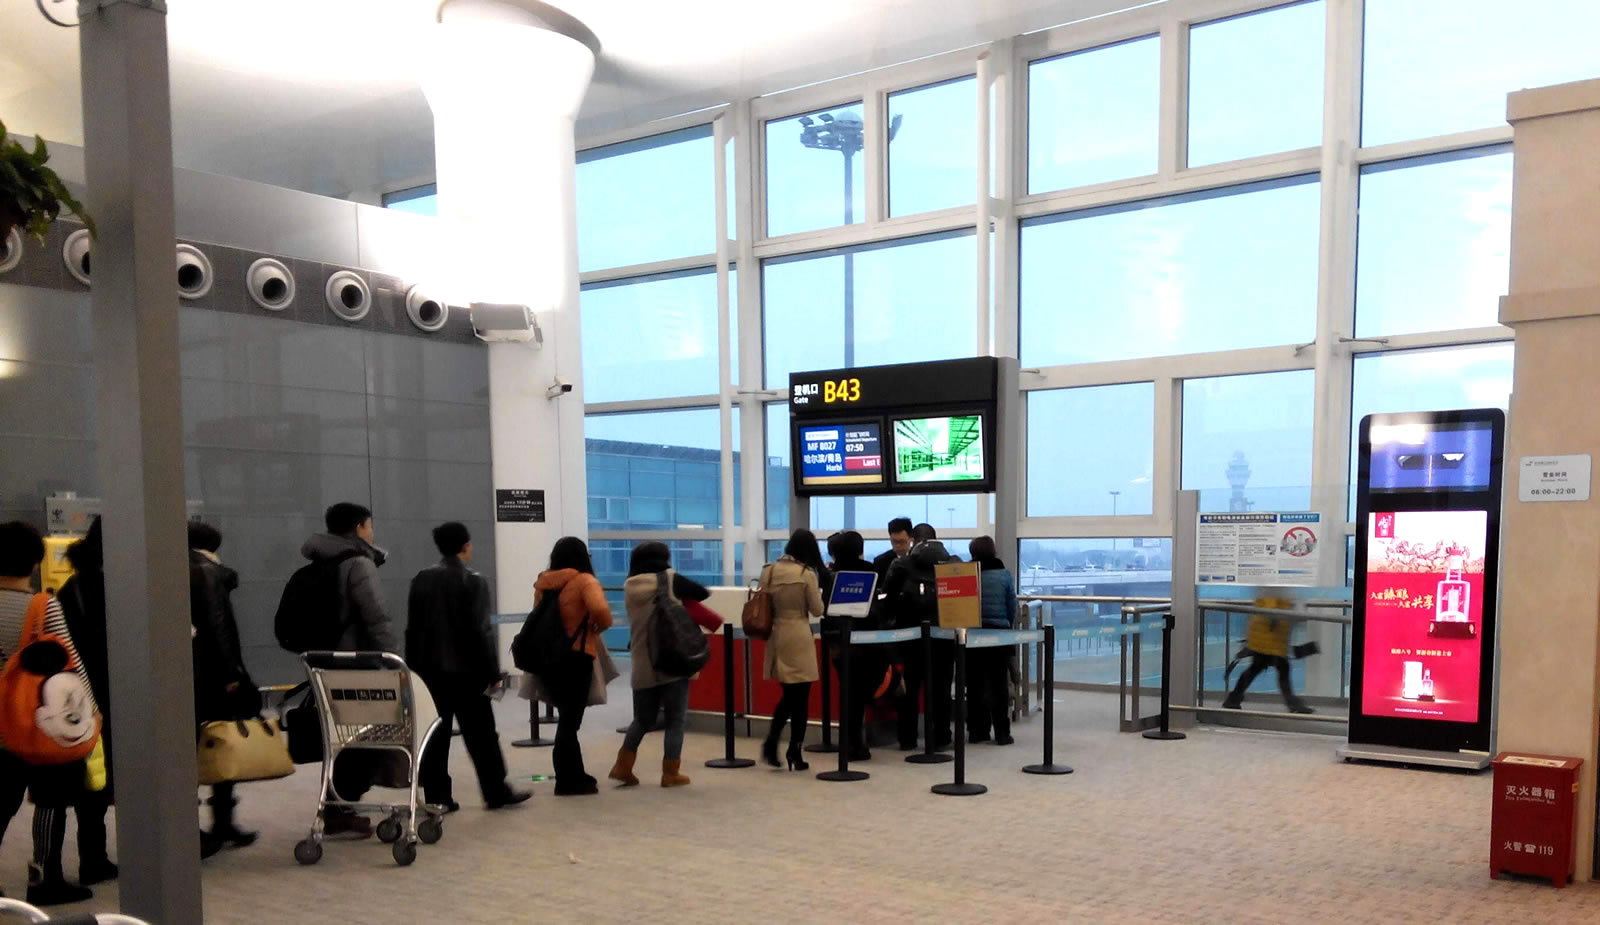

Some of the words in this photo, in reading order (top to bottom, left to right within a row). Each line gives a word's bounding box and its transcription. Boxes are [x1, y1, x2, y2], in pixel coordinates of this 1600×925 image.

[794, 384, 818, 396] 登机口
[824, 378, 860, 403] B43
[793, 396, 809, 404] Gate
[807, 443, 818, 451] MF
[820, 441, 836, 451] 8027
[845, 443, 864, 452] 07:50
[863, 458, 876, 466] Last
[1506, 785, 1555, 800] 灭火器箱
[1504, 840, 1522, 852] 火警
[1539, 846, 1553, 856] 119
